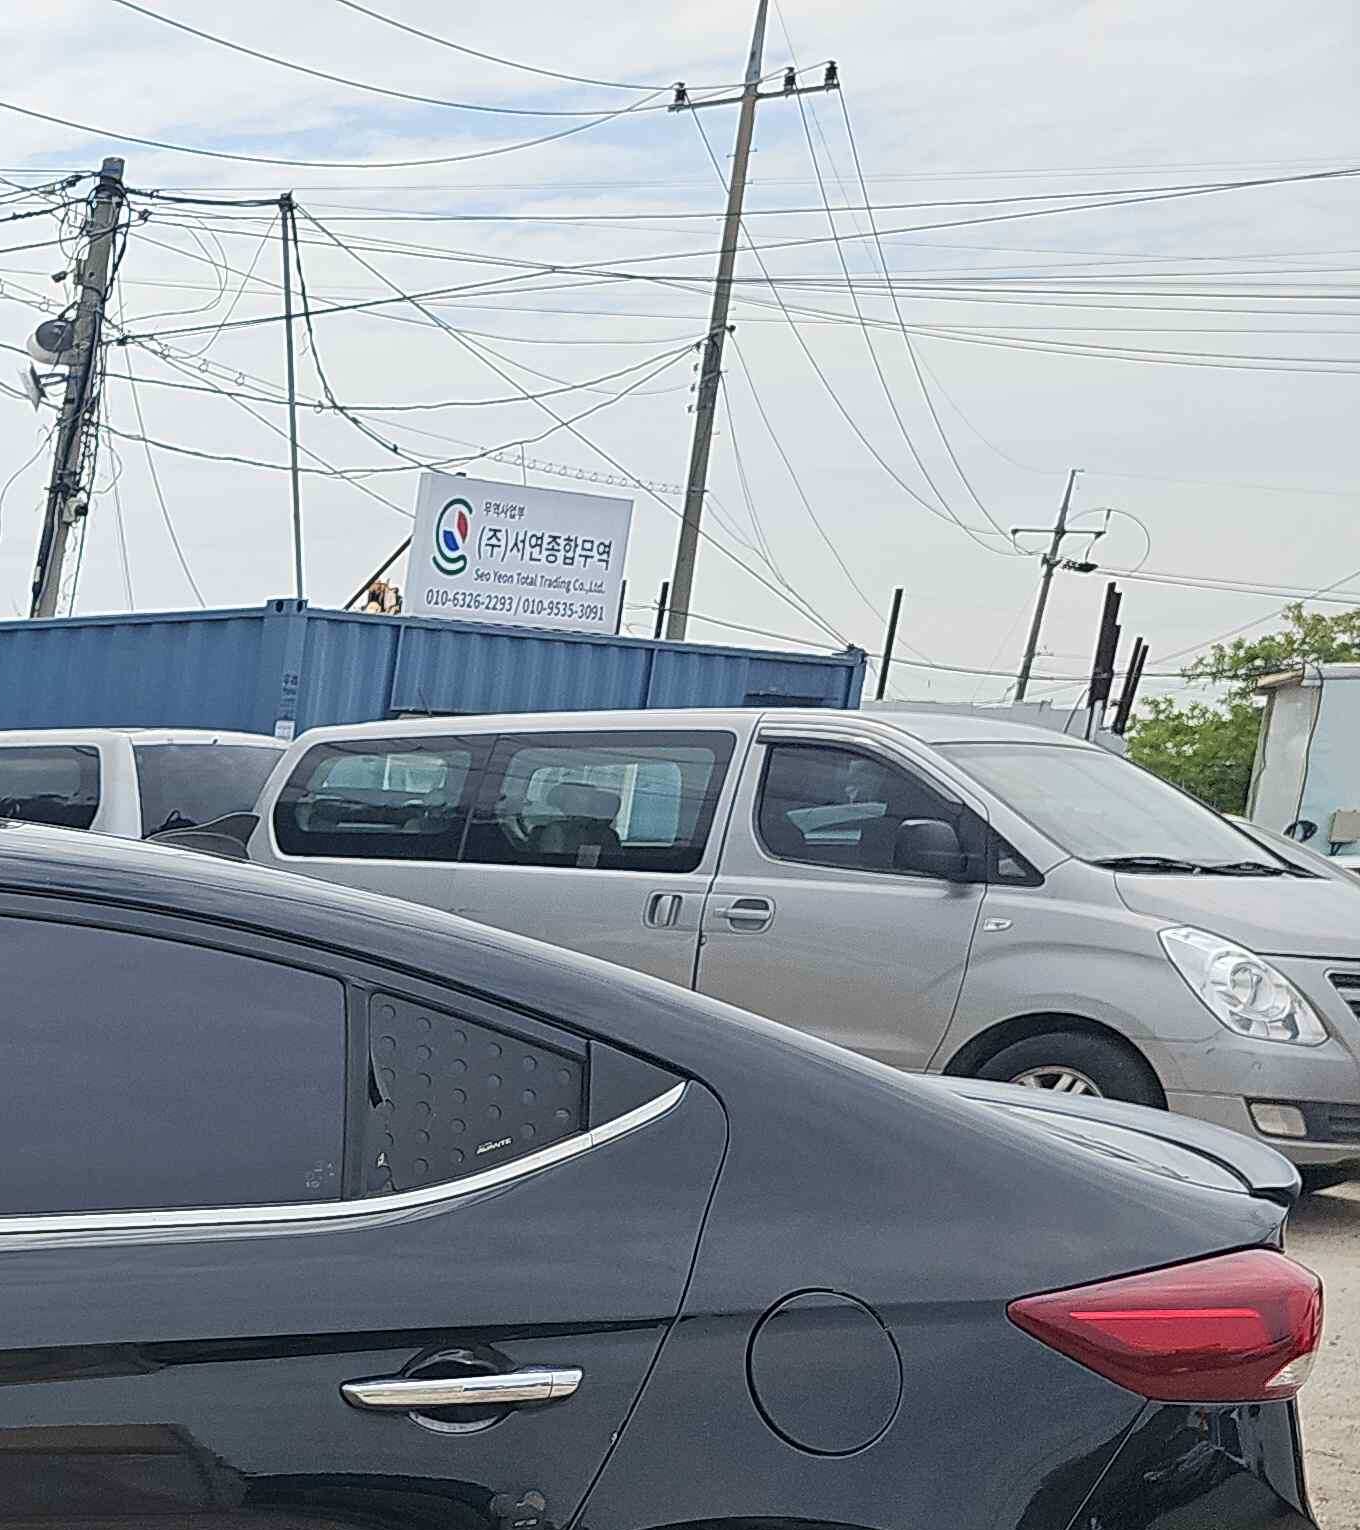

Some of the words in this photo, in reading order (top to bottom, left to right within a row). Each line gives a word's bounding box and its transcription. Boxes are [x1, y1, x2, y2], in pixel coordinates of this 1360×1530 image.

[477, 526, 613, 571] (주)서연종합무역
[473, 567, 491, 584] Seo
[492, 569, 514, 586] Yeon
[515, 571, 538, 588] Total
[539, 575, 571, 594] Trading
[425, 588, 513, 614] 010-6326-2293
[522, 597, 605, 622] 010-9535-3091
